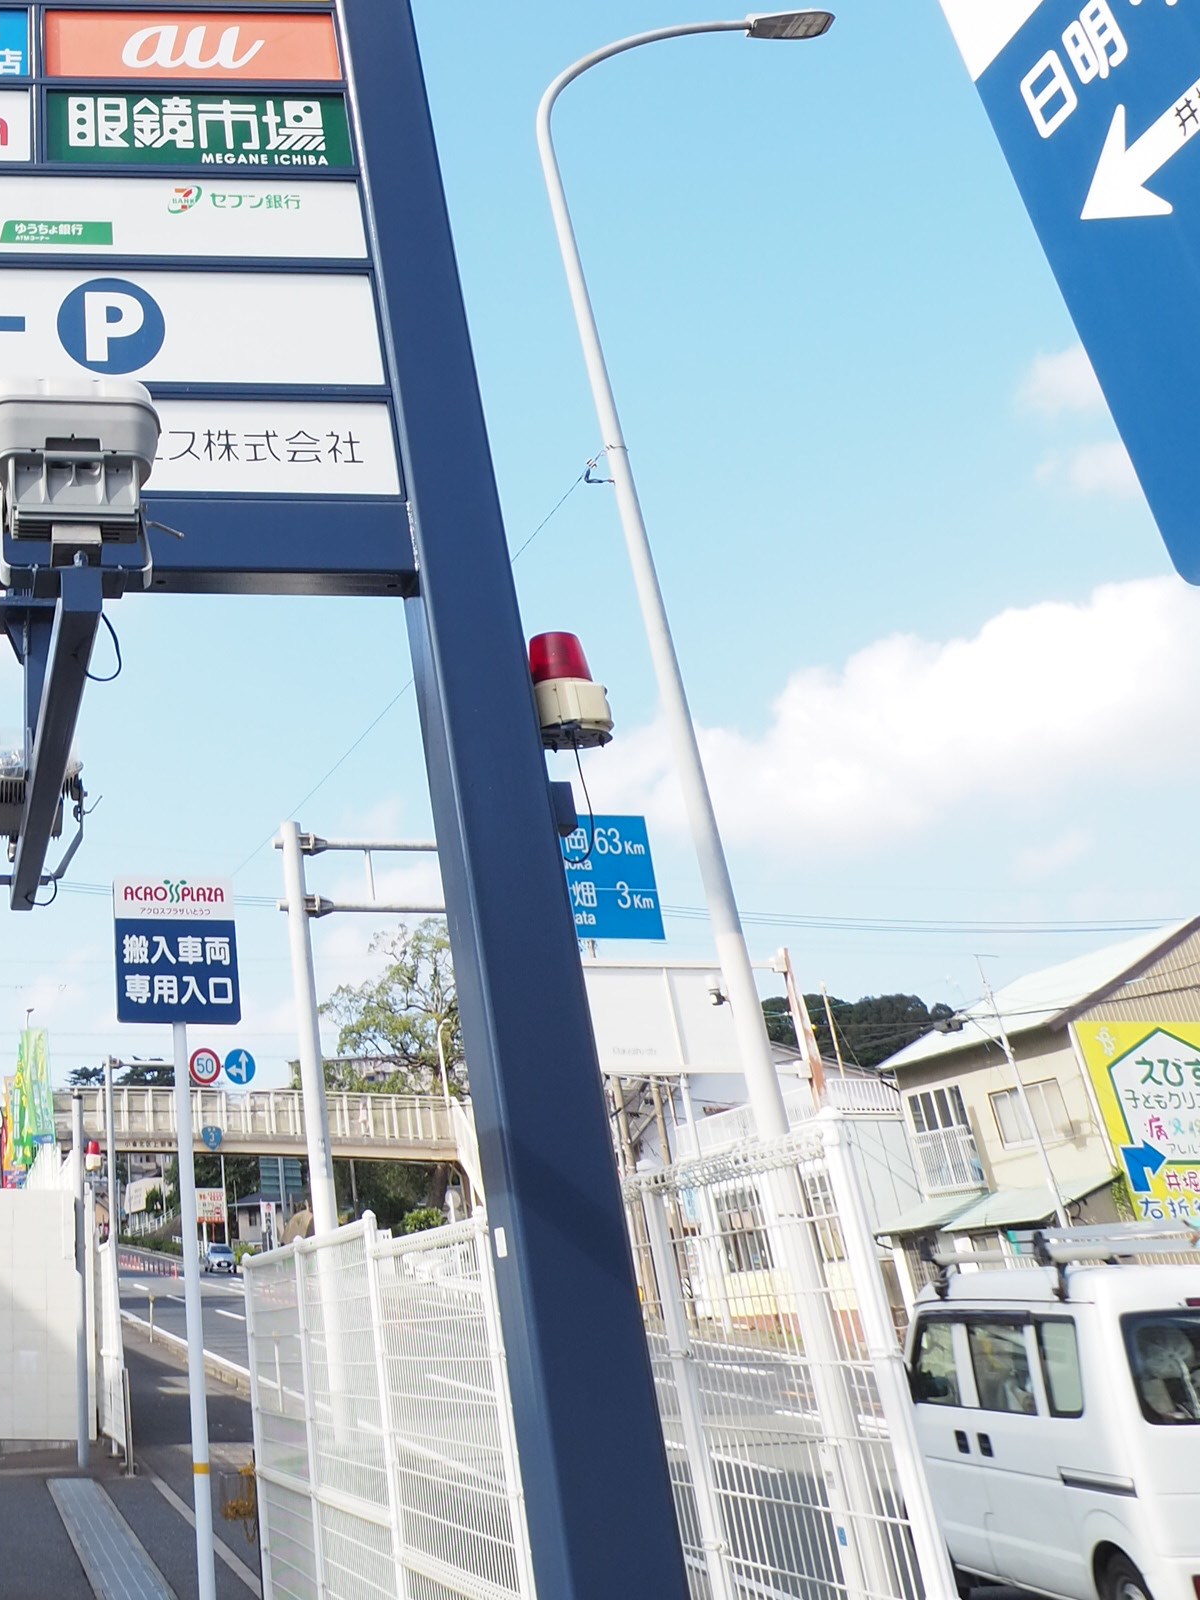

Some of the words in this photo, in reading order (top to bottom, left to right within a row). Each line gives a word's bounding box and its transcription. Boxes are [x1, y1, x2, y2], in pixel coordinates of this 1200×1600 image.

[121, 25, 266, 69] au
[67, 96, 326, 152] 眼鏡市場
[201, 152, 267, 164] MEGANE
[274, 154, 329, 165] ICHIBA
[210, 192, 300, 210] セブン銀行
[14, 223, 83, 236] ゆうちょ銀行
[84, 292, 144, 361] P
[594, 828, 622, 854] 63
[625, 841, 645, 855] Km
[572, 881, 597, 907] 畑
[616, 881, 631, 908] 3
[633, 894, 654, 908] Km
[123, 934, 230, 965] 搬入車両
[125, 974, 233, 1004] 専用入口
[196, 1058, 214, 1074] 50
